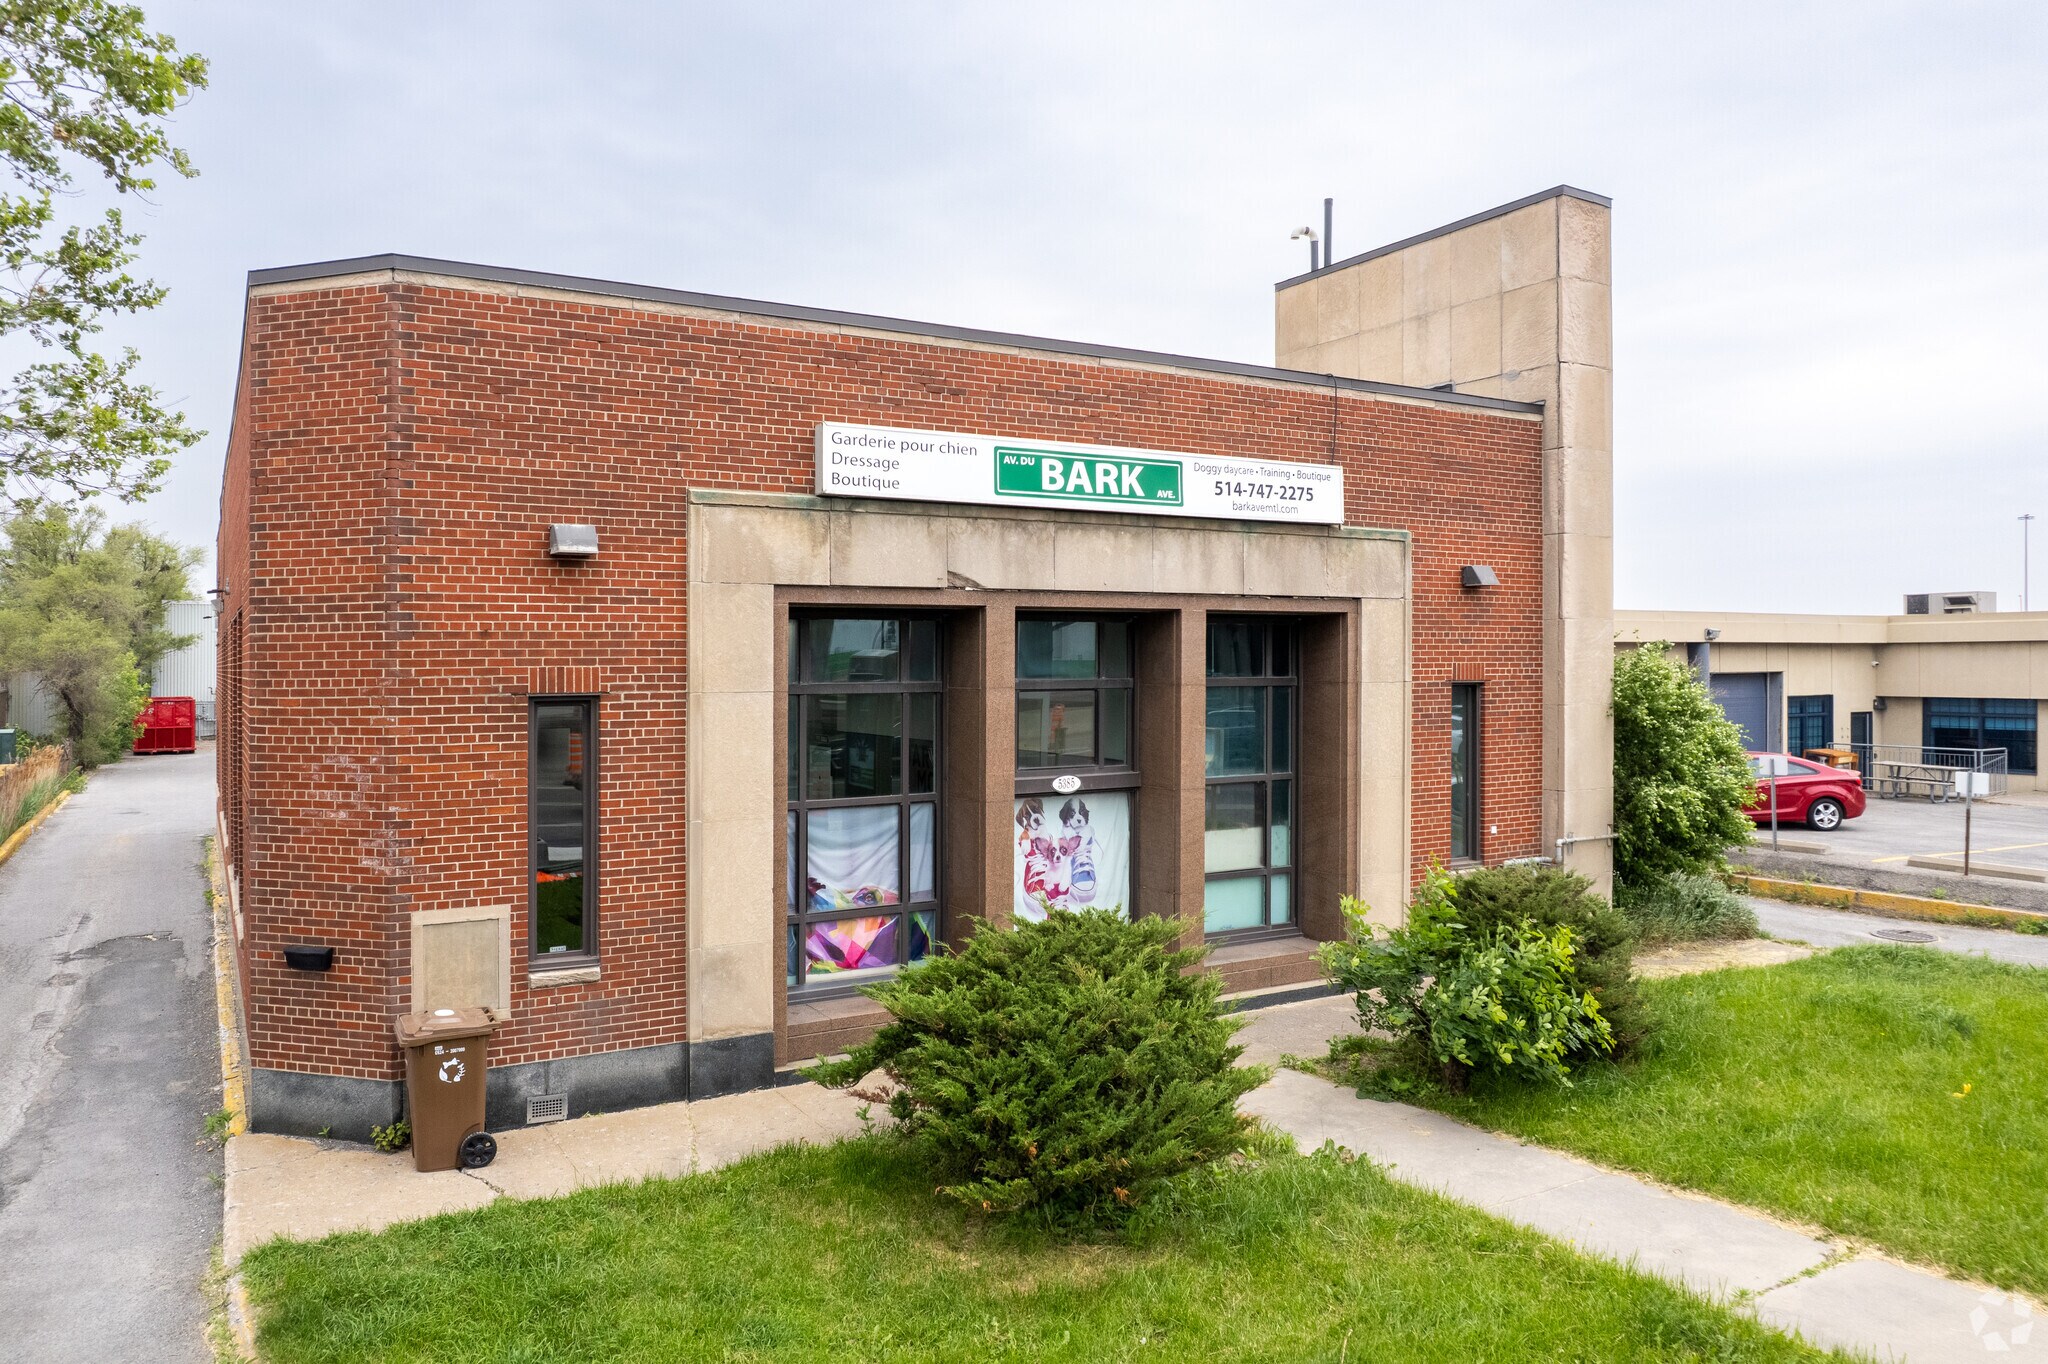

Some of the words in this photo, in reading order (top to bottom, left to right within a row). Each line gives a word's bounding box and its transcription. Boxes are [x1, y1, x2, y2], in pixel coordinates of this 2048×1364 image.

[831, 432, 896, 450] Garderie
[900, 439, 935, 454] pour
[939, 441, 978, 456] chien
[831, 451, 900, 472] Dressage
[1003, 455, 1019, 465] AV.
[1020, 456, 1035, 466] DU
[1041, 458, 1145, 497] BARK
[1193, 462, 1222, 475] Doggy
[1224, 464, 1254, 476] daycare
[1260, 467, 1291, 480] Training
[1296, 471, 1332, 481] Boutique
[831, 472, 900, 491] Boutique
[1214, 481, 1314, 501] 514-747-2275
[1156, 489, 1176, 499] AVE.
[1232, 500, 1299, 514] barkavemtl.com
[1057, 777, 1076, 790] 5385
